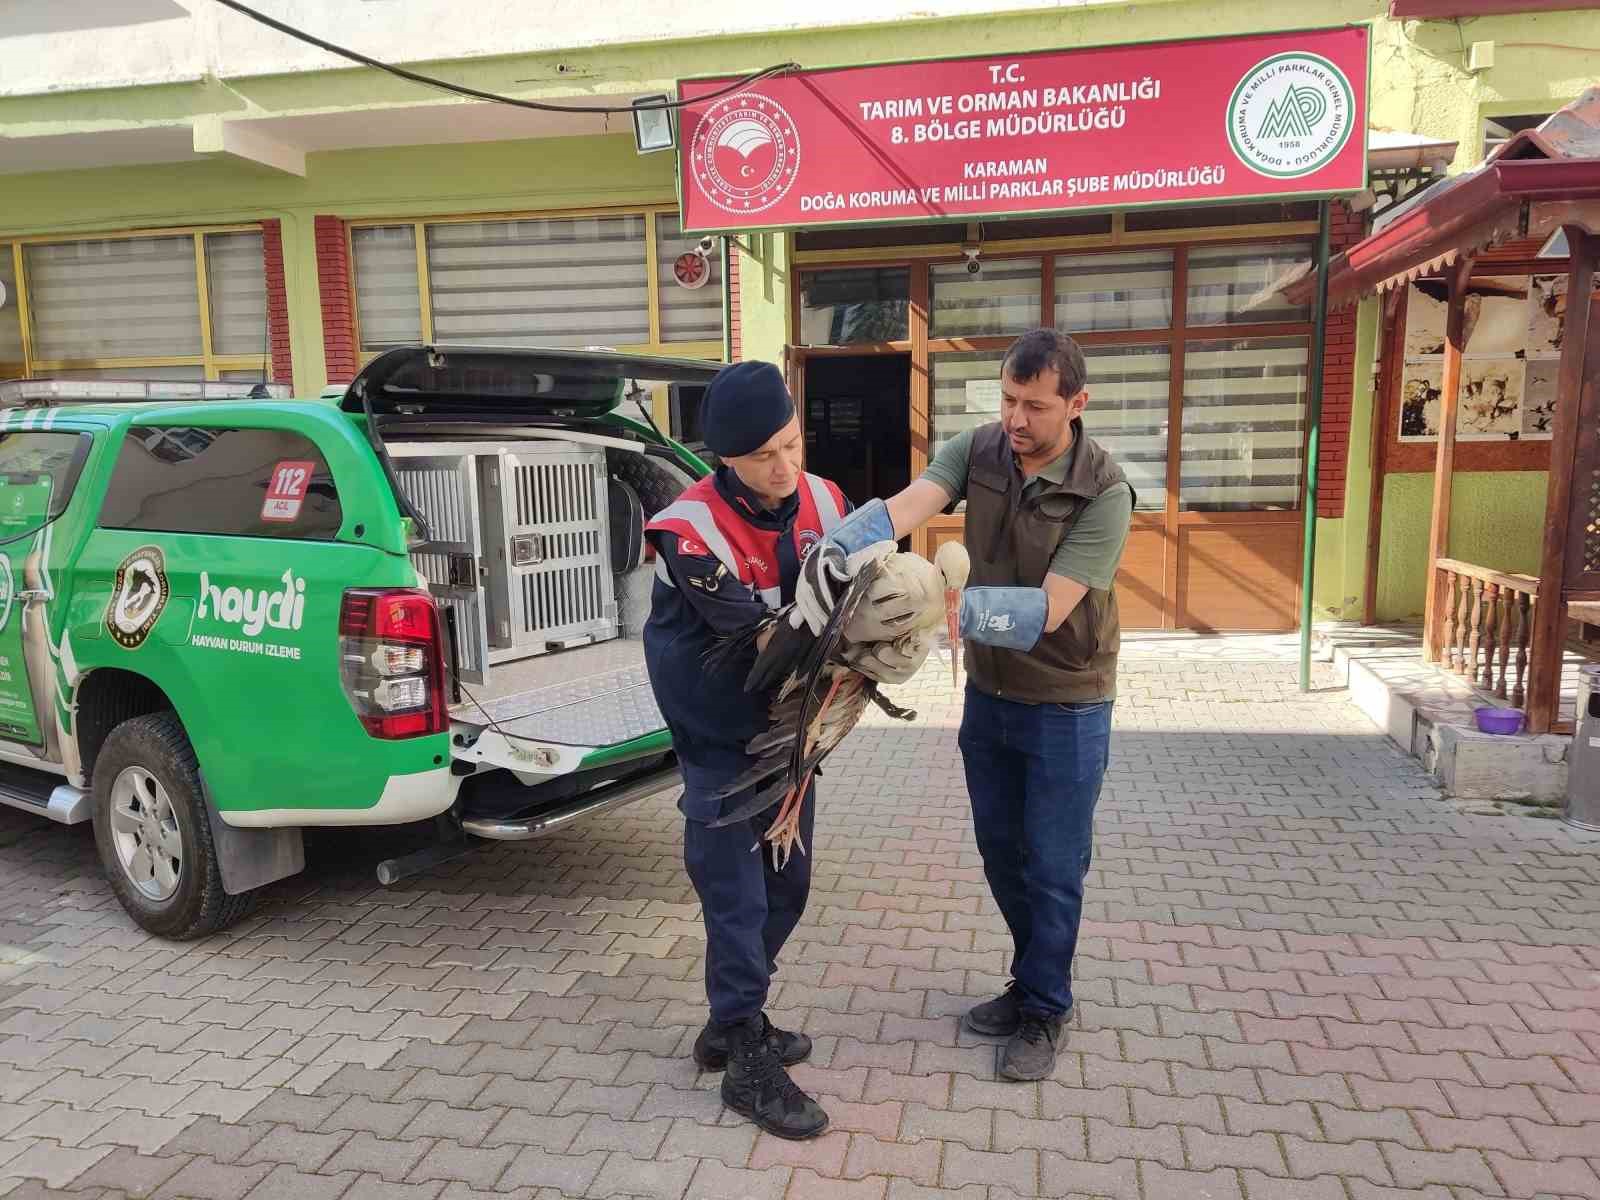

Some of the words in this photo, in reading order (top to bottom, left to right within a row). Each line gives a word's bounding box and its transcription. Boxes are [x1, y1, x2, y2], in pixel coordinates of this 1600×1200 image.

[988, 63, 1025, 85] T.C.
[1278, 64, 1325, 80] PARKLAR
[859, 98, 923, 121] TARIM
[926, 95, 953, 115] VE
[957, 89, 1038, 113] ORMAN
[1043, 76, 1161, 107] BAKANLIĞI
[1242, 93, 1253, 106] VE
[1325, 79, 1342, 111] GENEL
[891, 126, 909, 144] 8.
[914, 119, 981, 143] BÖLGE
[986, 105, 1126, 137] MÜDÜRLÜĞÜ
[1238, 108, 1257, 151] KORUMA
[964, 158, 1047, 179] KARAMAN
[801, 191, 846, 211] DOĞA
[849, 188, 918, 208] KORUMA
[921, 187, 940, 203] VE
[944, 181, 986, 202] MİLLİ
[990, 178, 1063, 198] PARKLAR
[1067, 175, 1109, 197] ŞUBE
[1113, 164, 1226, 191] MÜDÜRLÜĞÜ
[275, 468, 305, 495] 112
[197, 567, 306, 637] haydi
[191, 634, 228, 650] HAYVAN
[229, 639, 263, 655] DURUM
[265, 643, 301, 660] İZLEME
